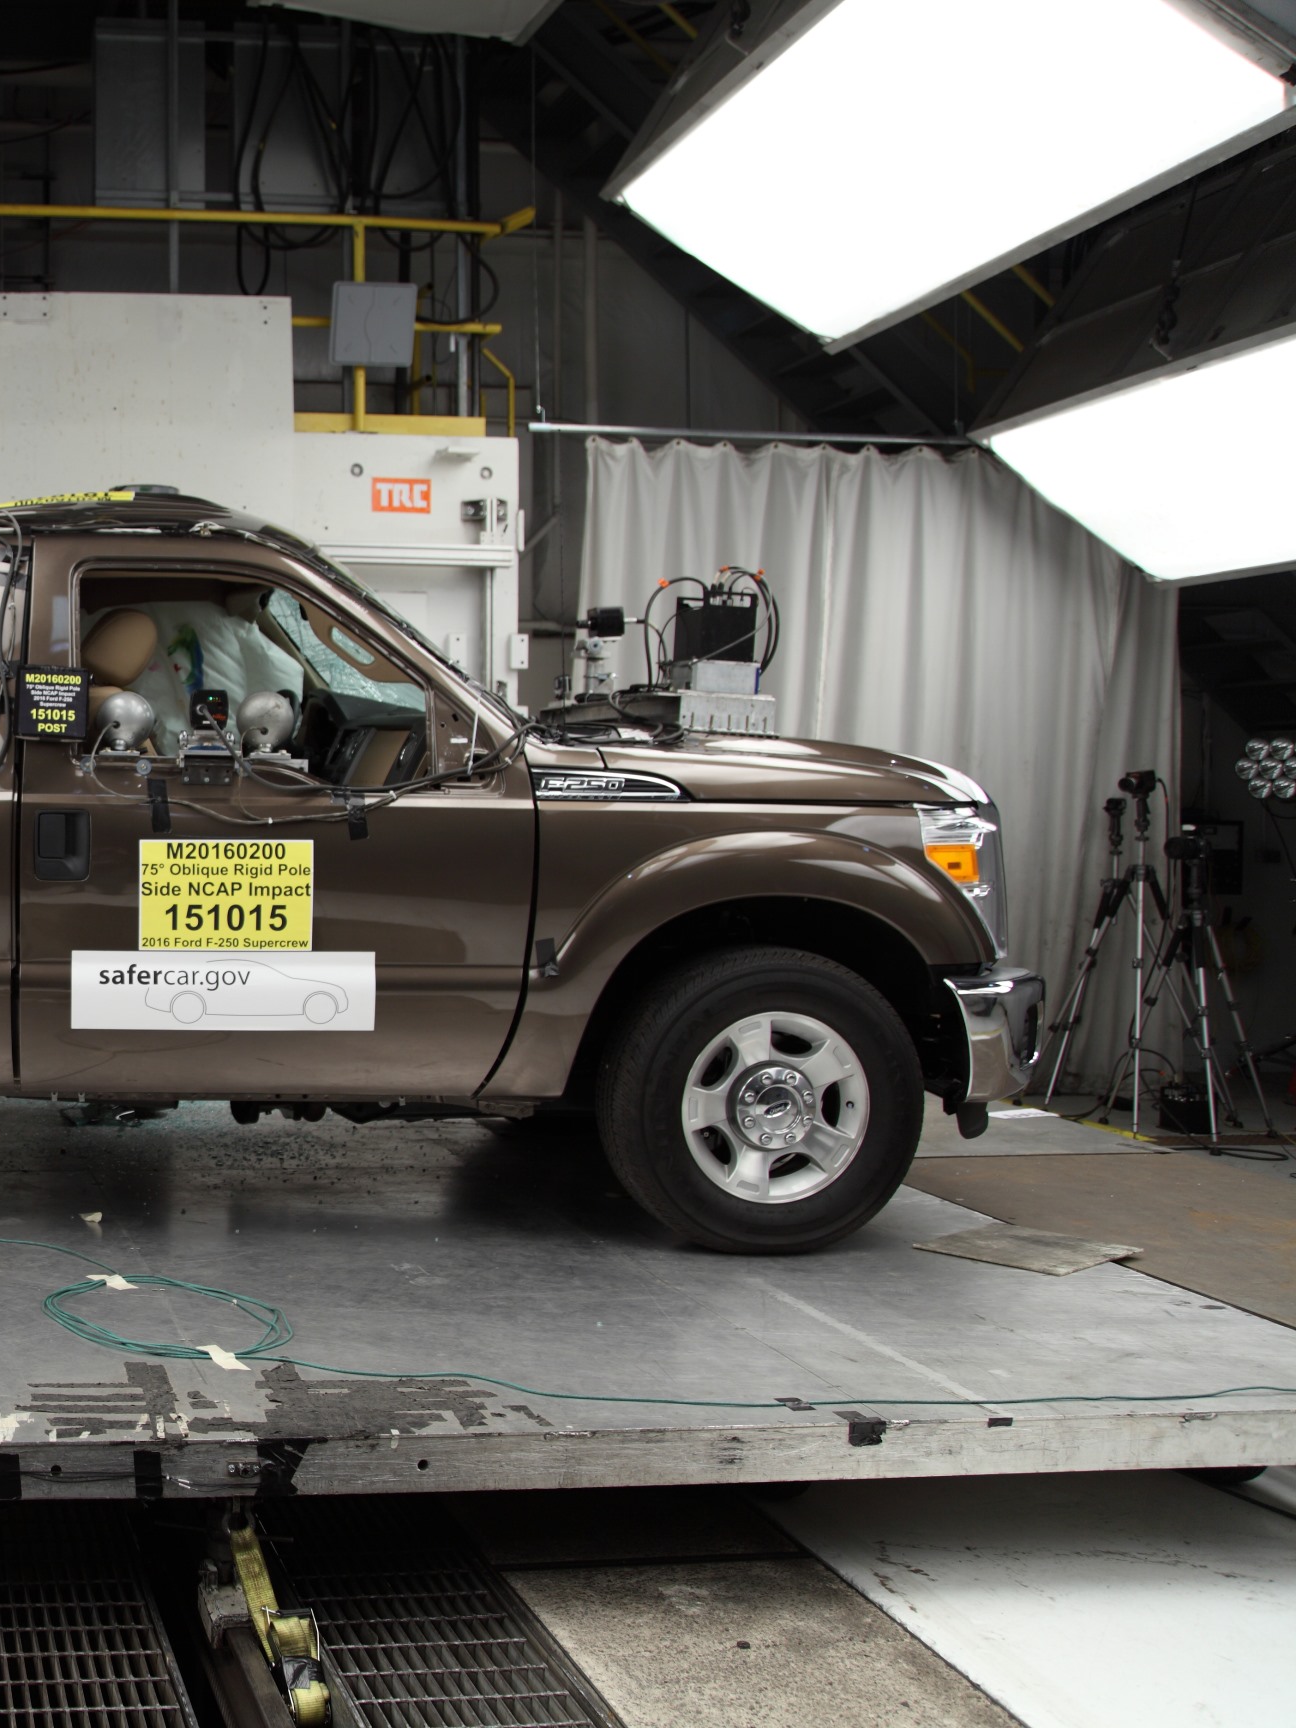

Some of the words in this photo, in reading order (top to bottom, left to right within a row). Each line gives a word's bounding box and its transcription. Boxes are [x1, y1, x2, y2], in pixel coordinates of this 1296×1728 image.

[376, 482, 428, 508] TRC
[25, 673, 82, 685] M20160200
[30, 708, 76, 721] 151015
[37, 723, 68, 733] POST
[166, 842, 286, 860] M20160200
[141, 863, 165, 876] 75°
[170, 863, 228, 878] Oblique
[234, 863, 273, 878] Rigid
[278, 864, 311, 877] Pole
[141, 881, 182, 897] Side
[188, 882, 243, 897] NCAP
[248, 882, 311, 900] Impact
[165, 904, 288, 931] 151015
[142, 937, 170, 947] 2016
[174, 937, 202, 948] Ford
[206, 937, 239, 948] F-250
[243, 938, 309, 950] Supercrew
[99, 964, 250, 991] safercar.gov
